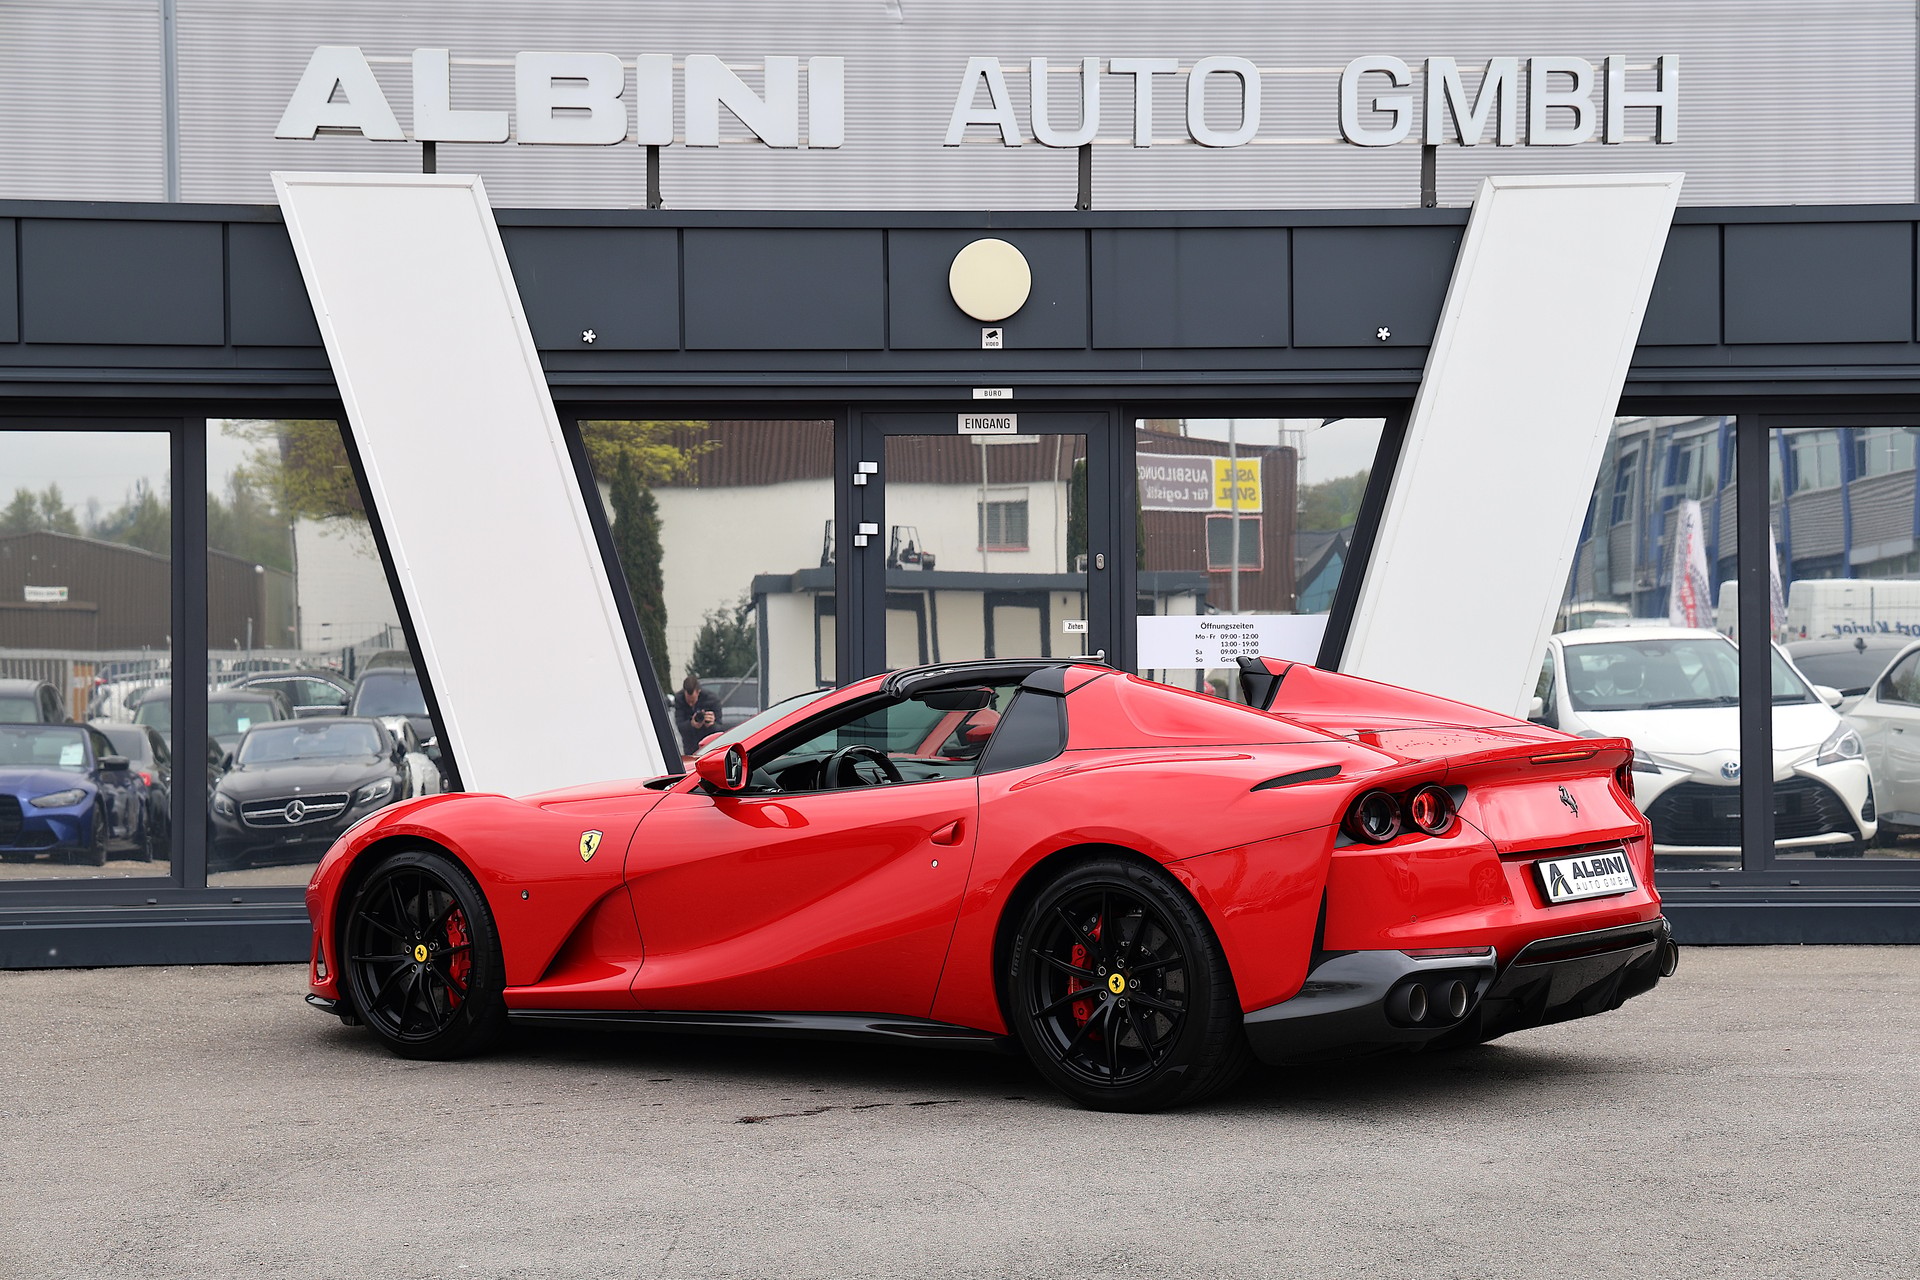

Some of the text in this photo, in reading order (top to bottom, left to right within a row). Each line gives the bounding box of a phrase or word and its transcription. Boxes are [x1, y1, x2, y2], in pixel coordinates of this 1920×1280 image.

[274, 45, 1679, 149] ALBINI AUTO GMBH
[984, 389, 1002, 397] BÜRO
[965, 418, 1011, 429] EINGANG
[1200, 622, 1254, 630] Öffnungszeiten
[1572, 856, 1626, 879] ALBINI
[1575, 876, 1630, 891] AUTO GMBH
